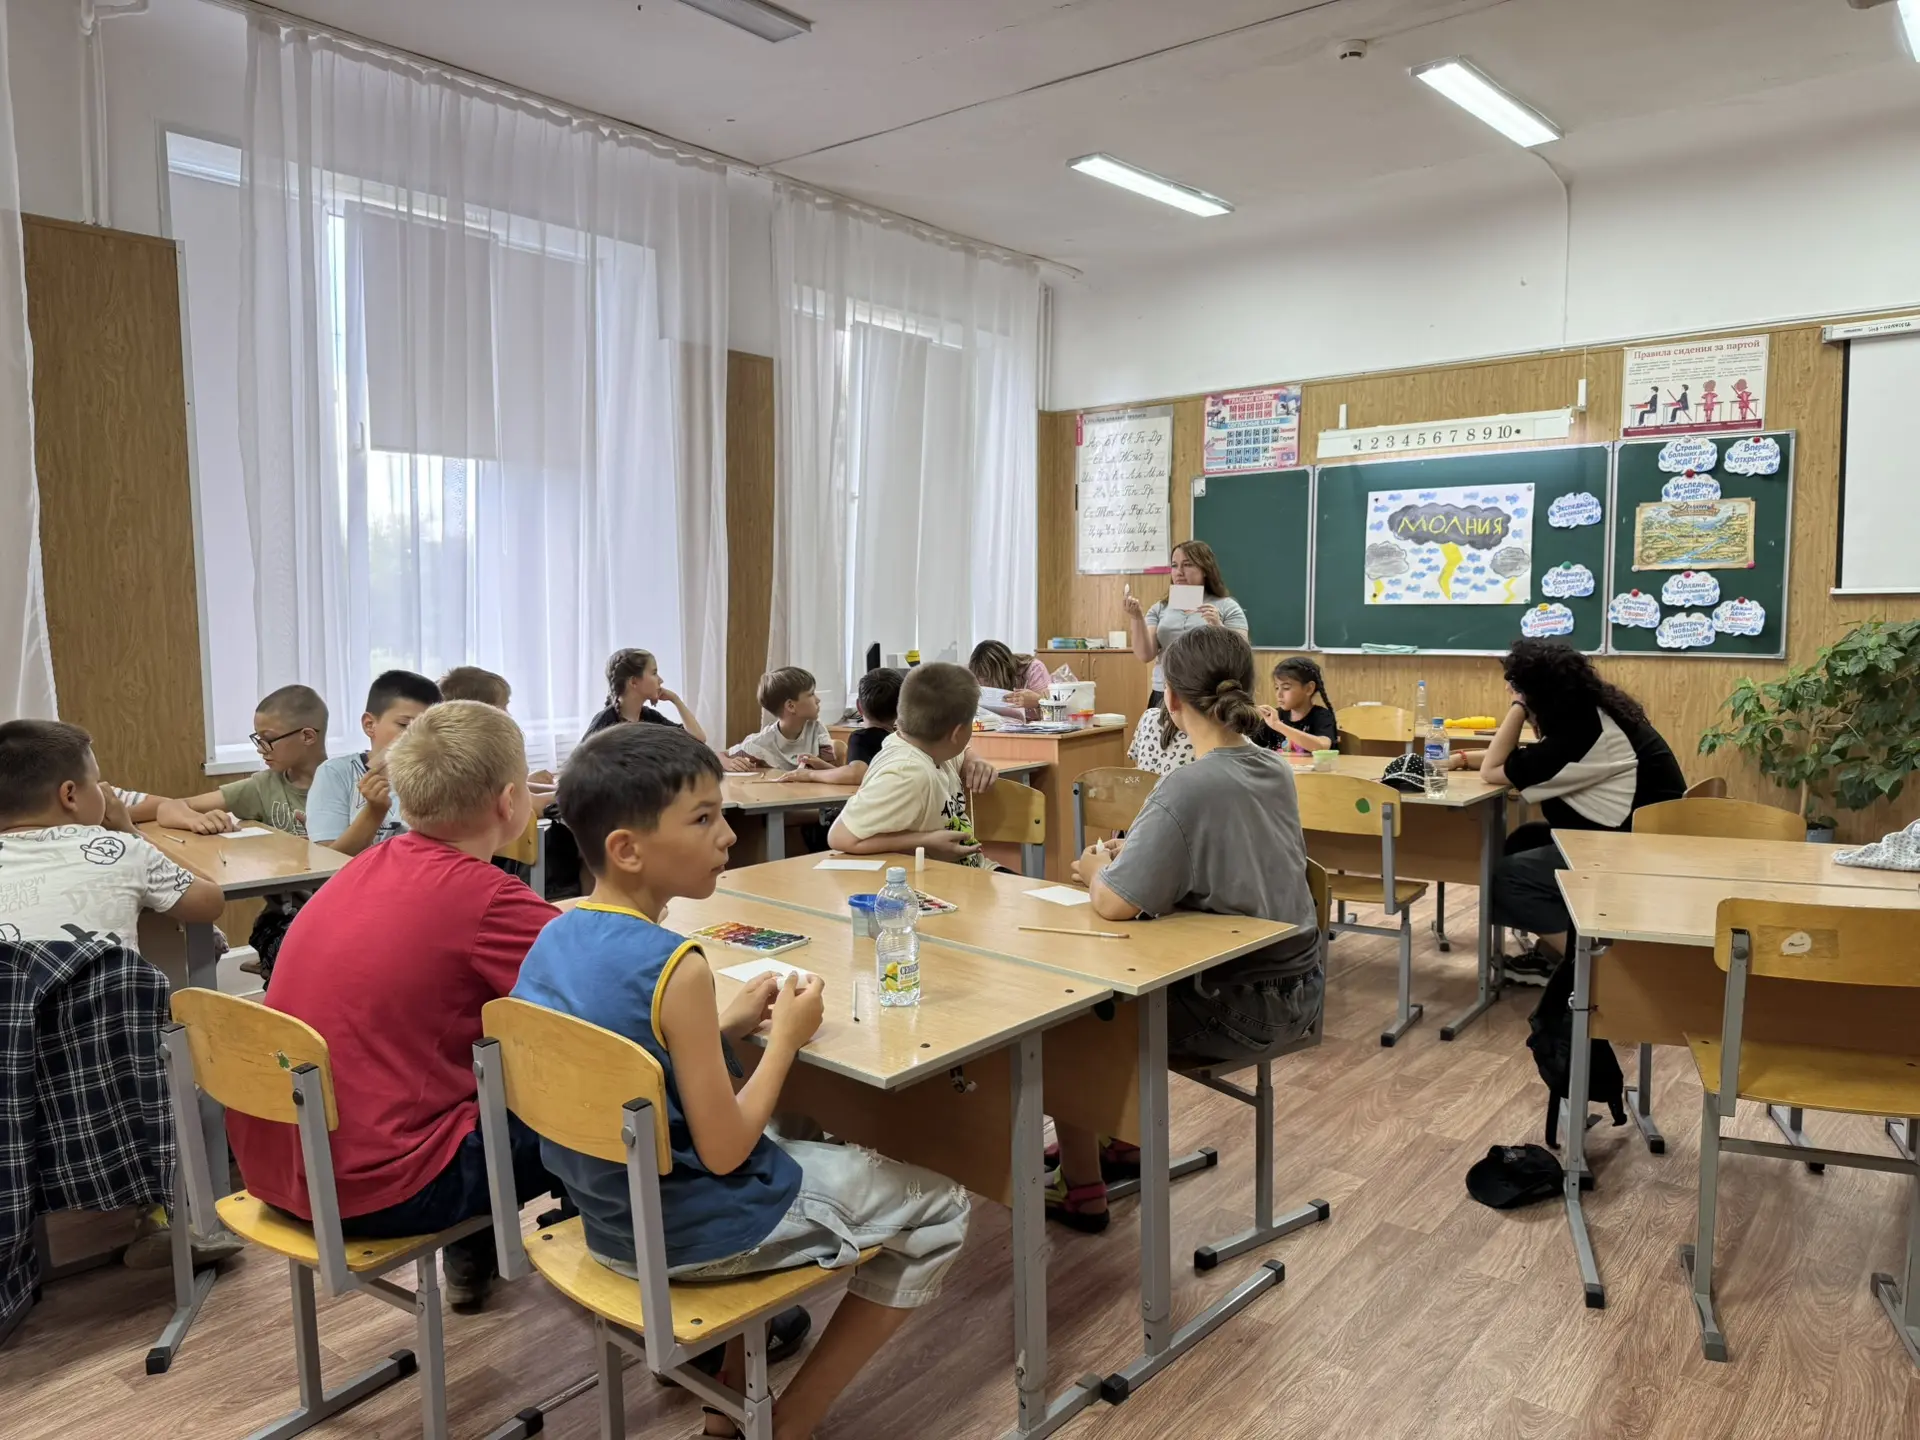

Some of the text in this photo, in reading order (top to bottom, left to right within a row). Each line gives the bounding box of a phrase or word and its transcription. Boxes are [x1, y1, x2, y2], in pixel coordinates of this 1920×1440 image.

[1634, 349, 1671, 360] Правила
[1673, 346, 1712, 356] сидения
[1726, 340, 1760, 351] партой
[1357, 425, 1512, 450] 1 2 3 4 5 6 7 8 9 10
[1398, 514, 1504, 535] МОЛНИЯ
